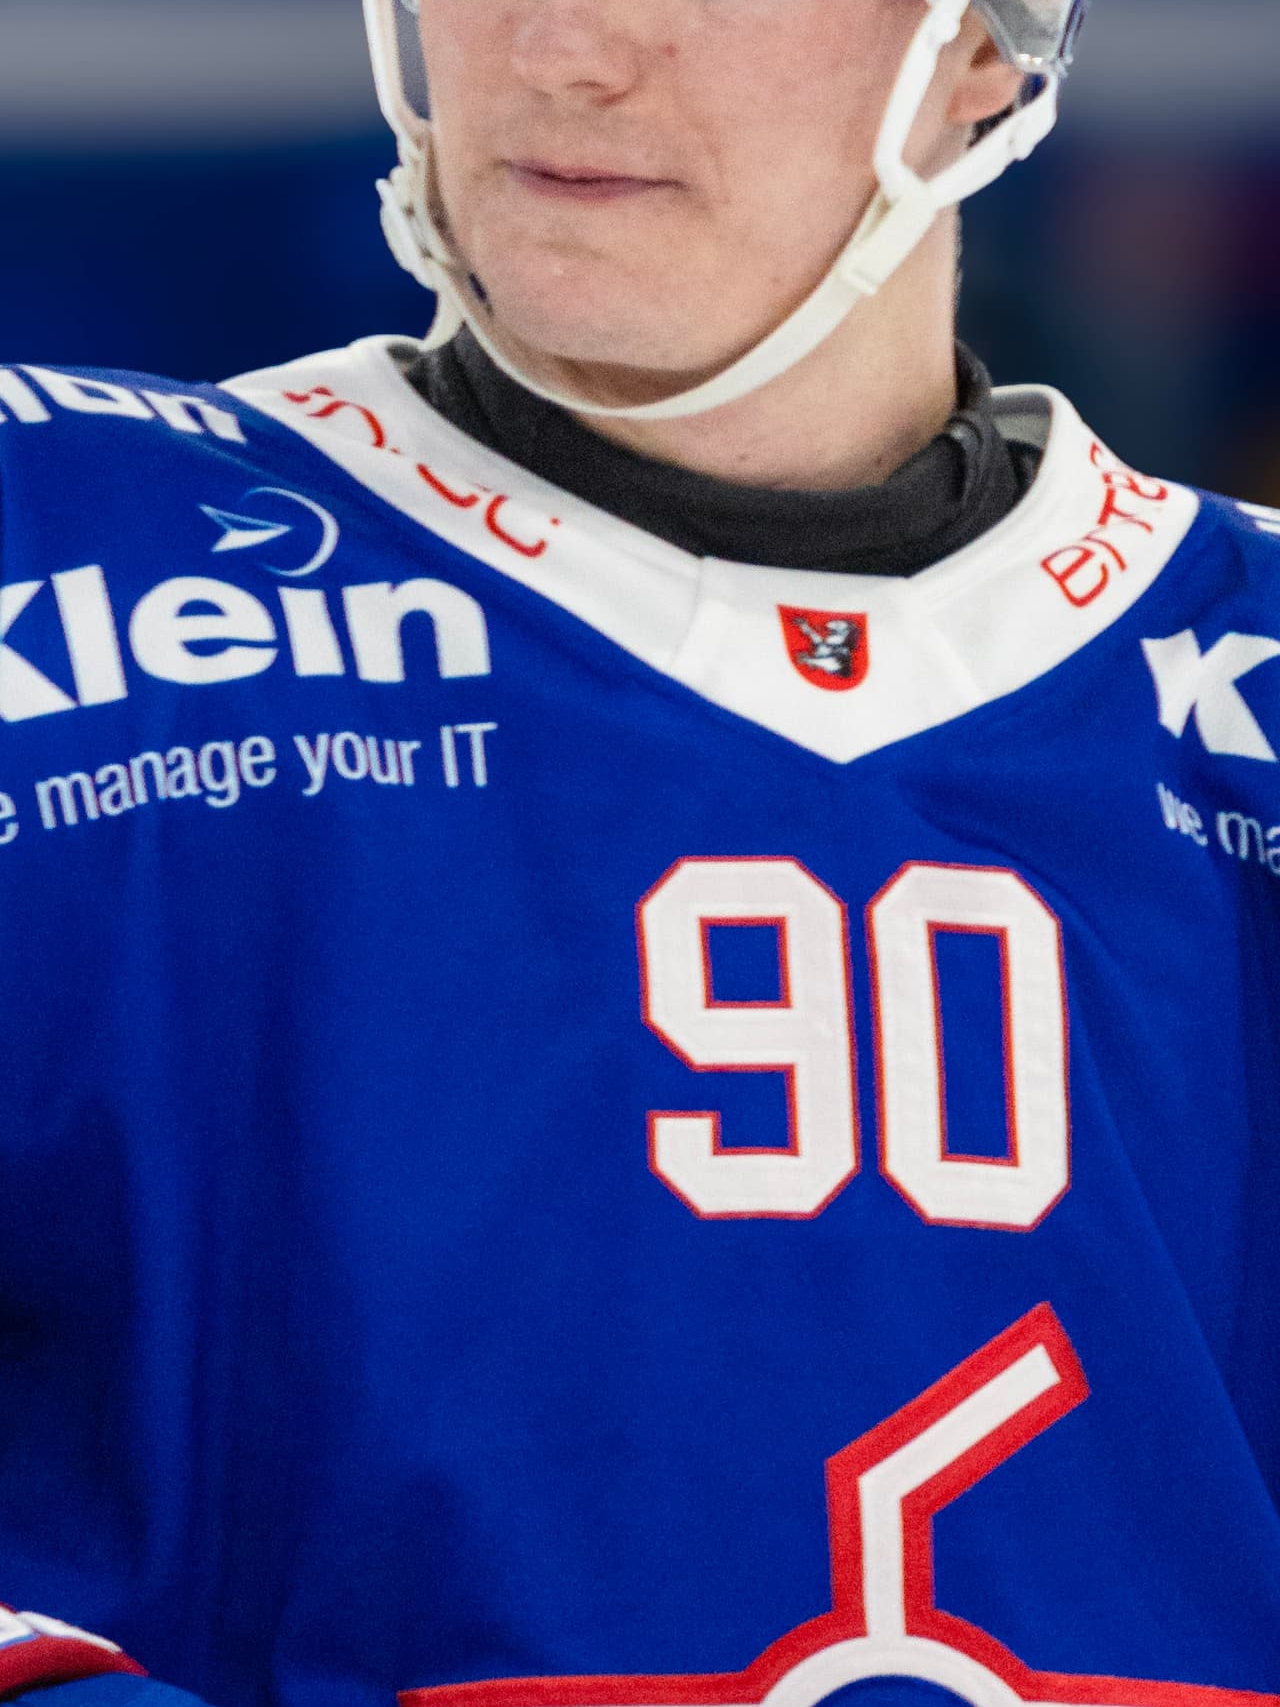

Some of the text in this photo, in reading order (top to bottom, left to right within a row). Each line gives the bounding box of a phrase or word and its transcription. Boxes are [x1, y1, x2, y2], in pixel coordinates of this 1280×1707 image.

[36, 731, 278, 830] manage
[294, 730, 423, 797] your
[440, 721, 498, 788] IT
[634, 855, 1072, 1234] 90
